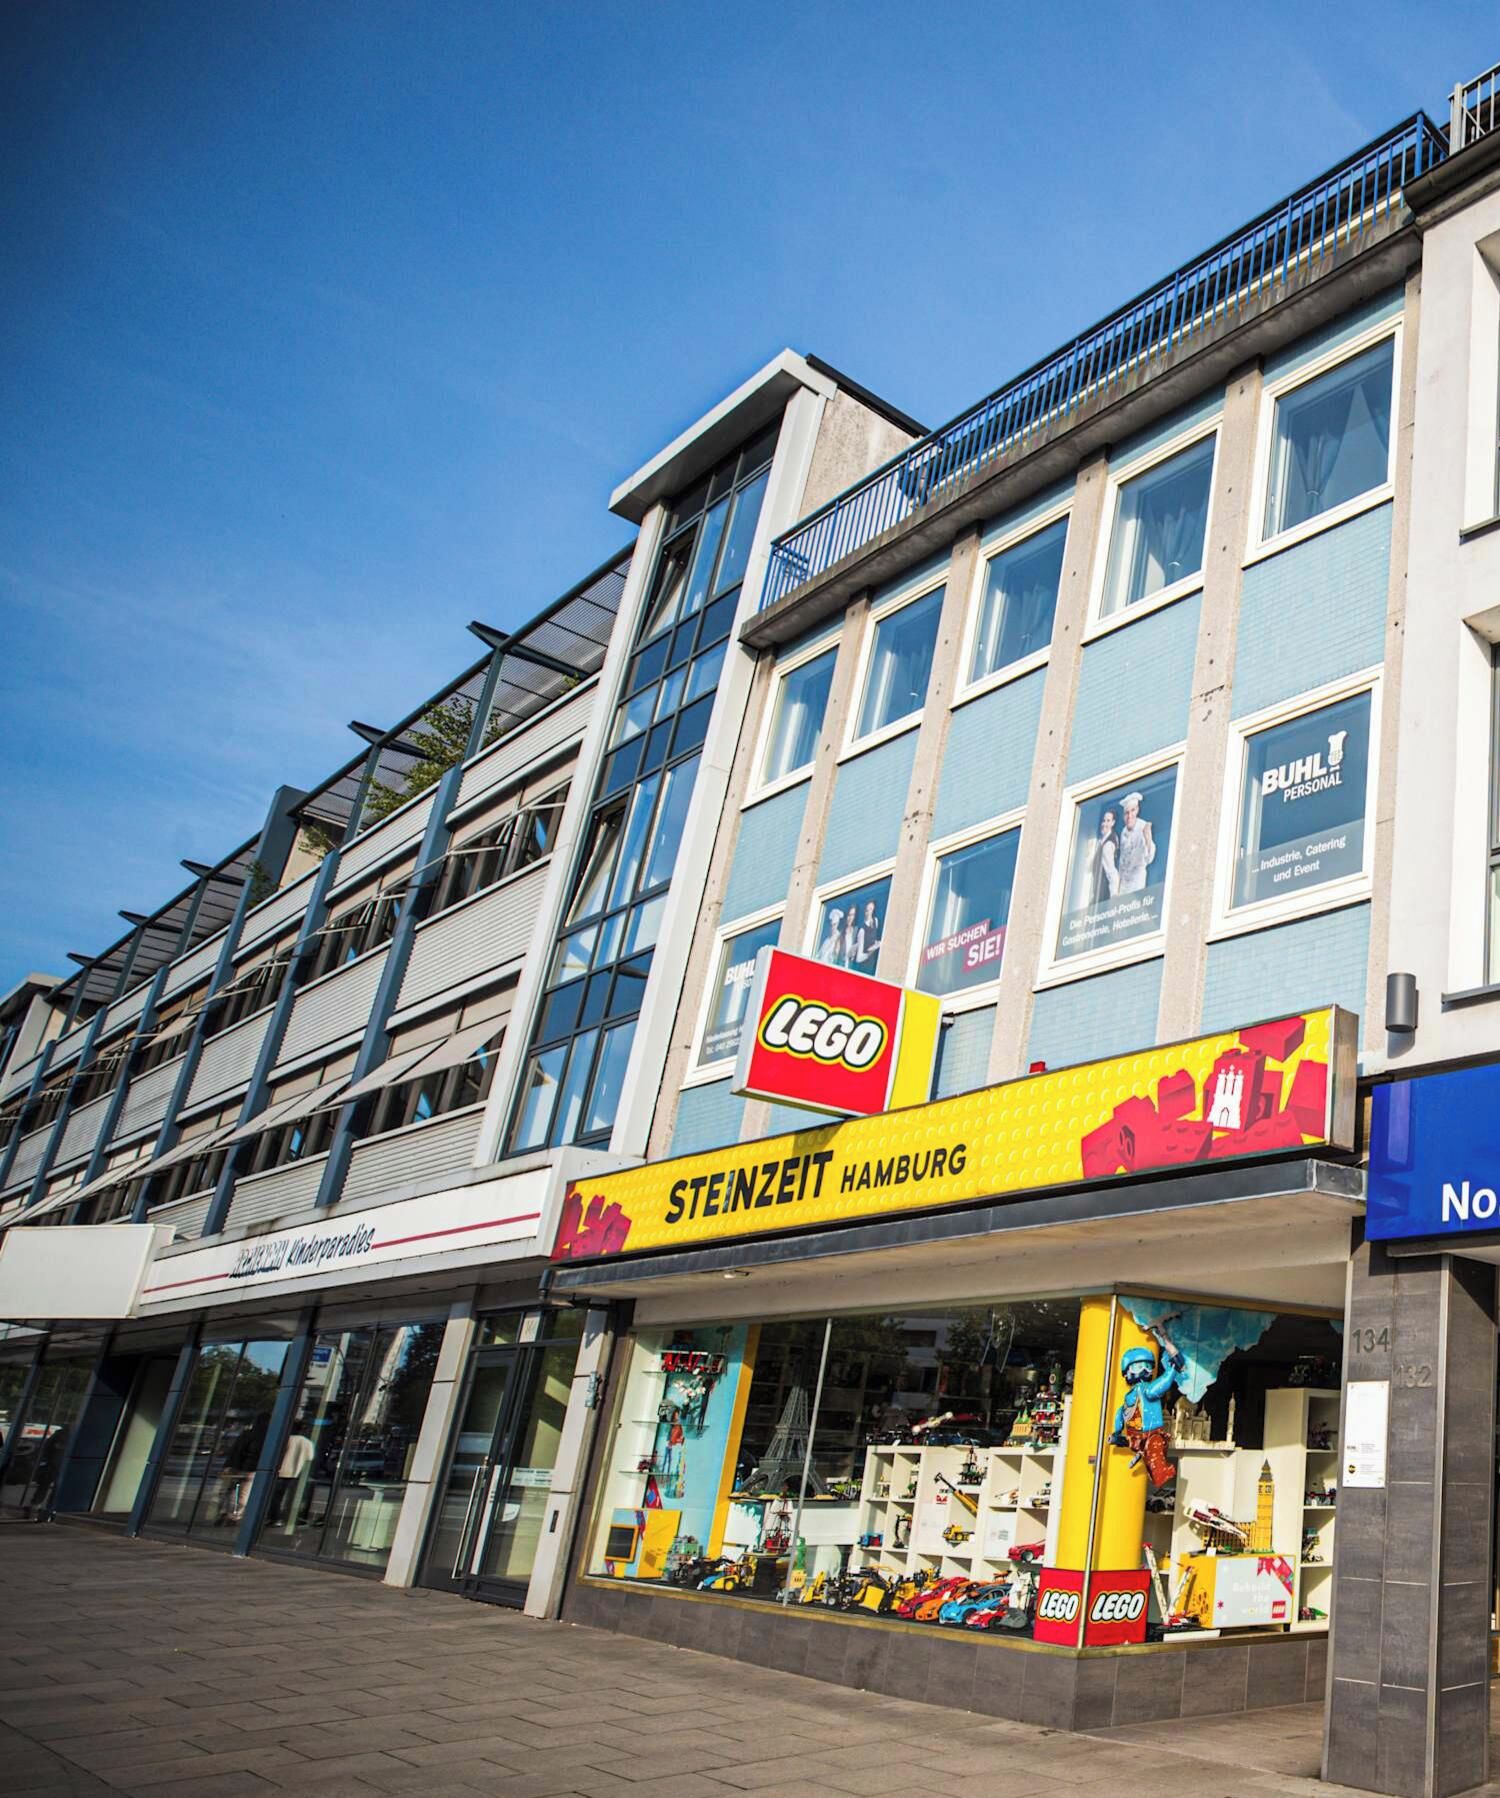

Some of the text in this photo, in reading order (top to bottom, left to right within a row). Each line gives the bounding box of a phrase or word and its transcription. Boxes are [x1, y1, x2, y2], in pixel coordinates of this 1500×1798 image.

[1261, 752, 1328, 796] BUHL
[1283, 771, 1343, 803] PERSONAL
[1305, 835, 1347, 857] Catering
[1273, 859, 1320, 883] und Event
[926, 922, 988, 960] WIR SUCHEN
[967, 933, 1002, 967] SIE!
[763, 998, 885, 1068] LEGO
[664, 1143, 967, 1224] STEINZEIT HAMBURG
[286, 1223, 376, 1268] Kinderparadies
[1352, 1327, 1391, 1354] 134
[1394, 1364, 1433, 1389] 132
[1039, 1590, 1080, 1621] LEGO
[1091, 1591, 1146, 1621] LEGO
